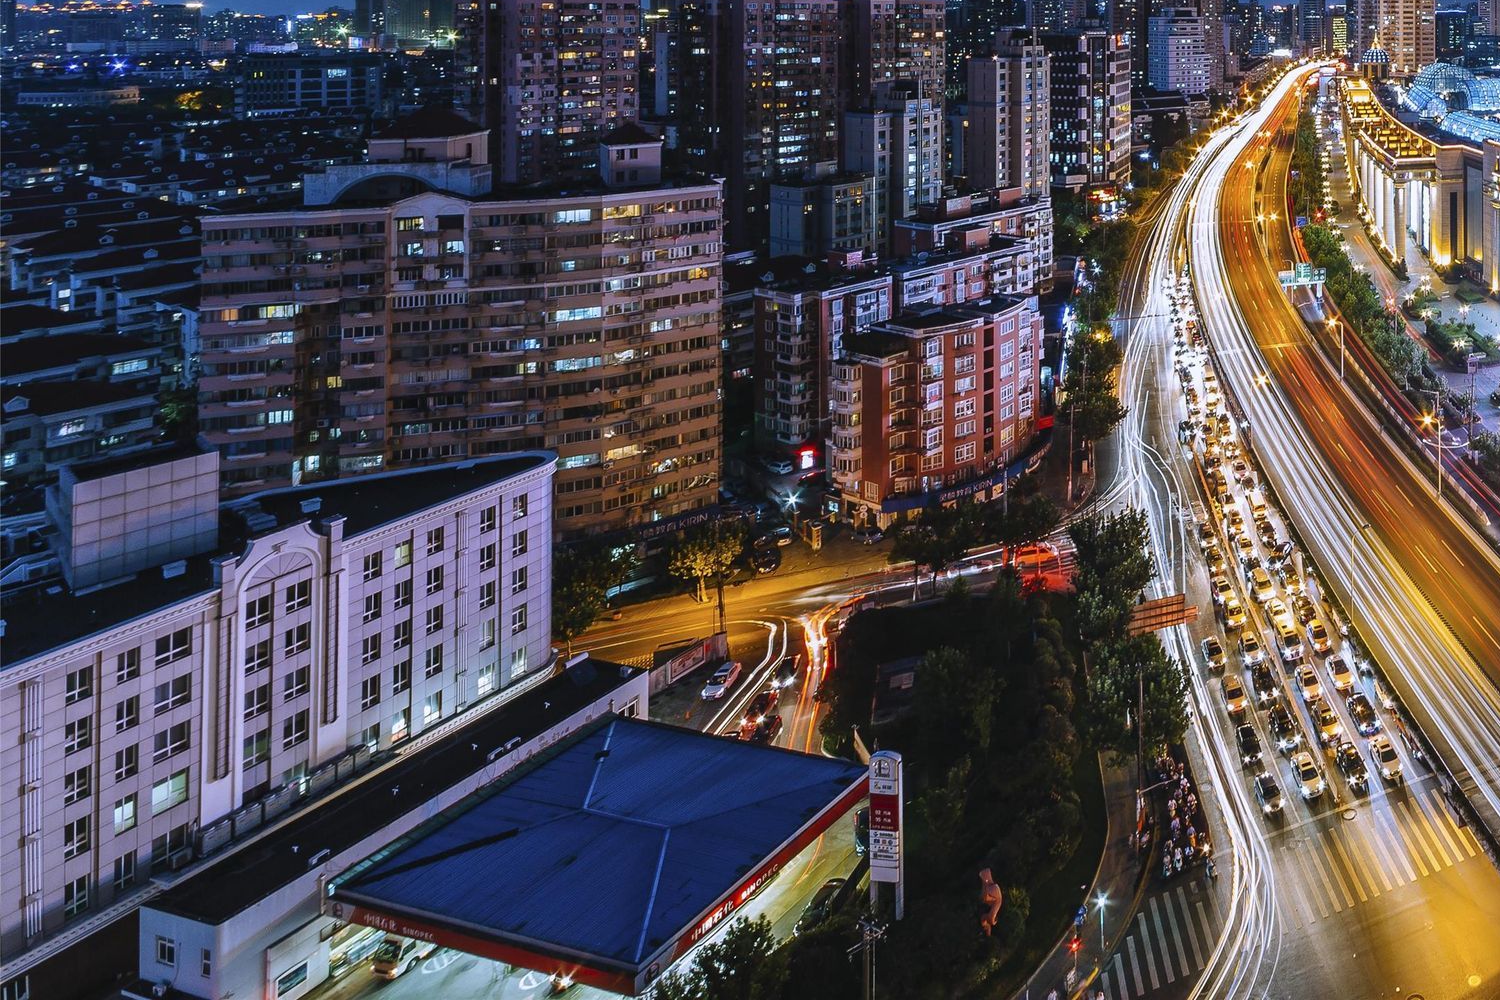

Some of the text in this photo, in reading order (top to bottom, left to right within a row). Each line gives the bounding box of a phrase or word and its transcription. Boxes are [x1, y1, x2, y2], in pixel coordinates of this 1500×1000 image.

[679, 513, 708, 529] KIRIN
[690, 863, 779, 941] 中国石化 SINOPEC
[402, 926, 434, 940] SINOPEC
